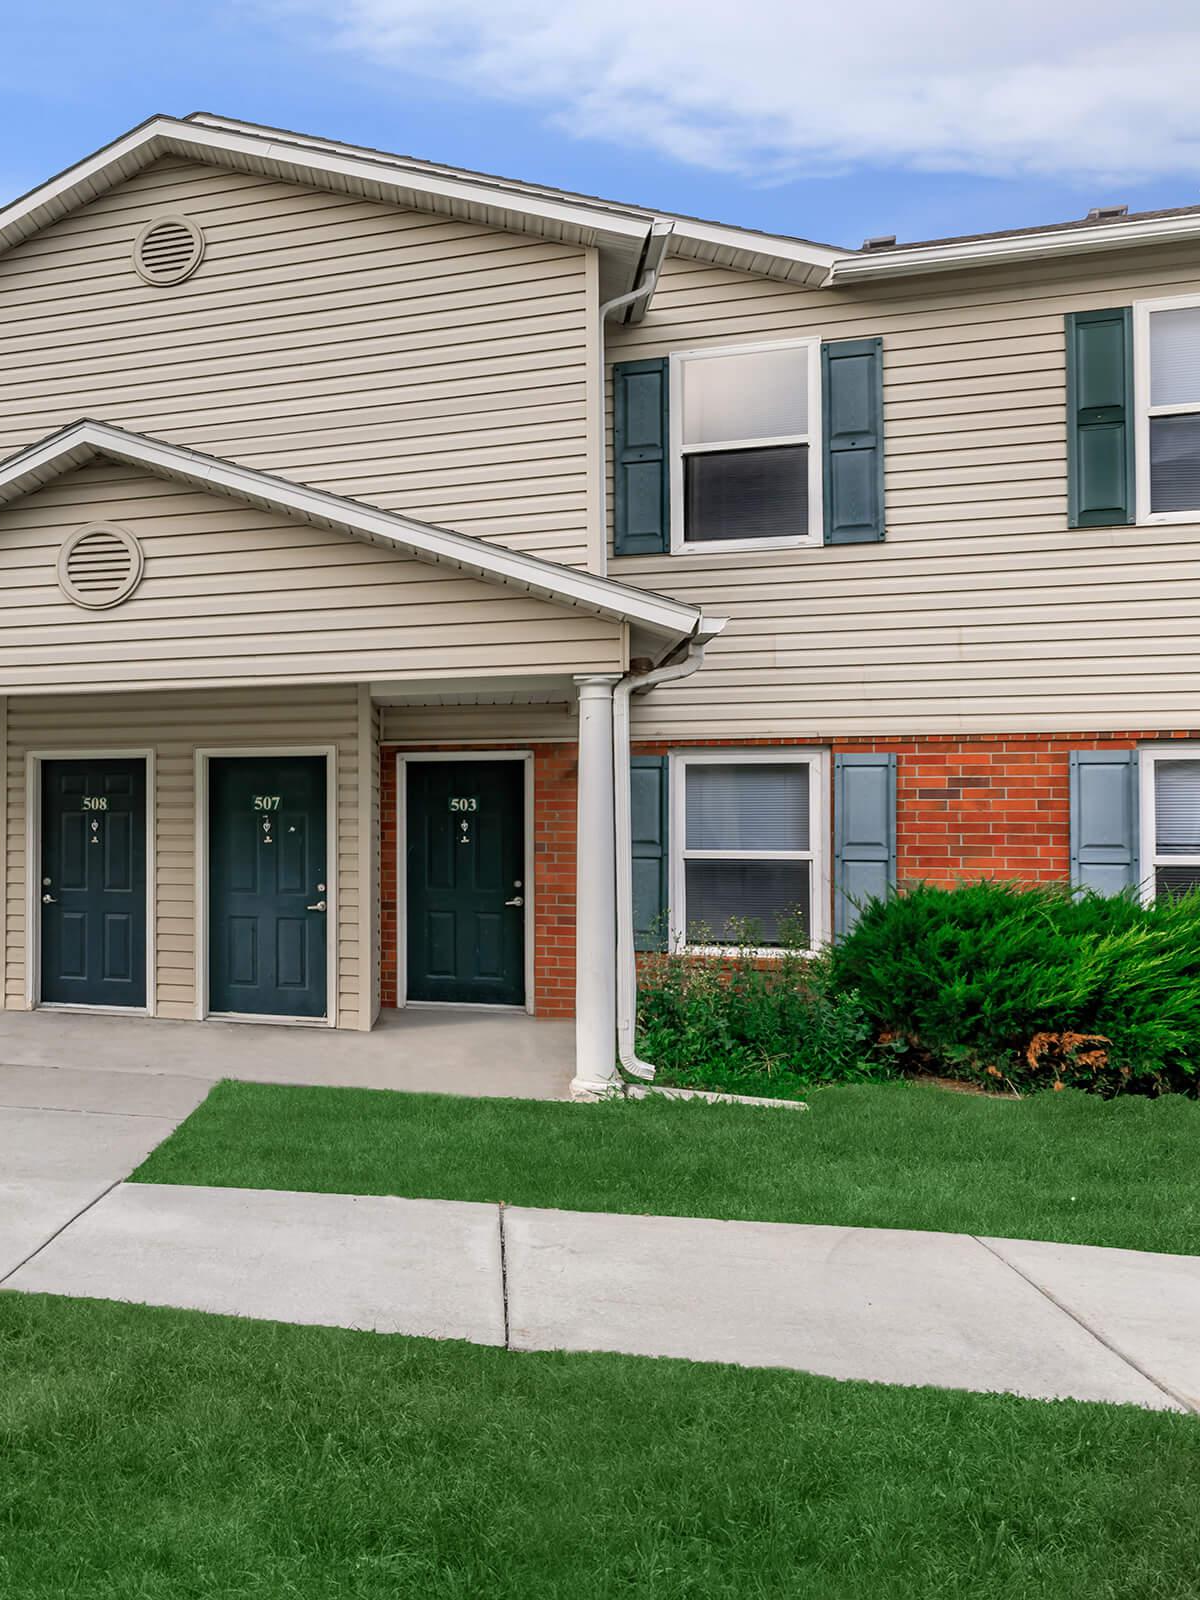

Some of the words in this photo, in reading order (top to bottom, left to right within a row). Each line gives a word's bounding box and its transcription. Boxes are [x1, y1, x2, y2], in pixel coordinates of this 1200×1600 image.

[82, 797, 107, 810] 508
[254, 797, 280, 810] 507
[450, 798, 477, 811] 503
